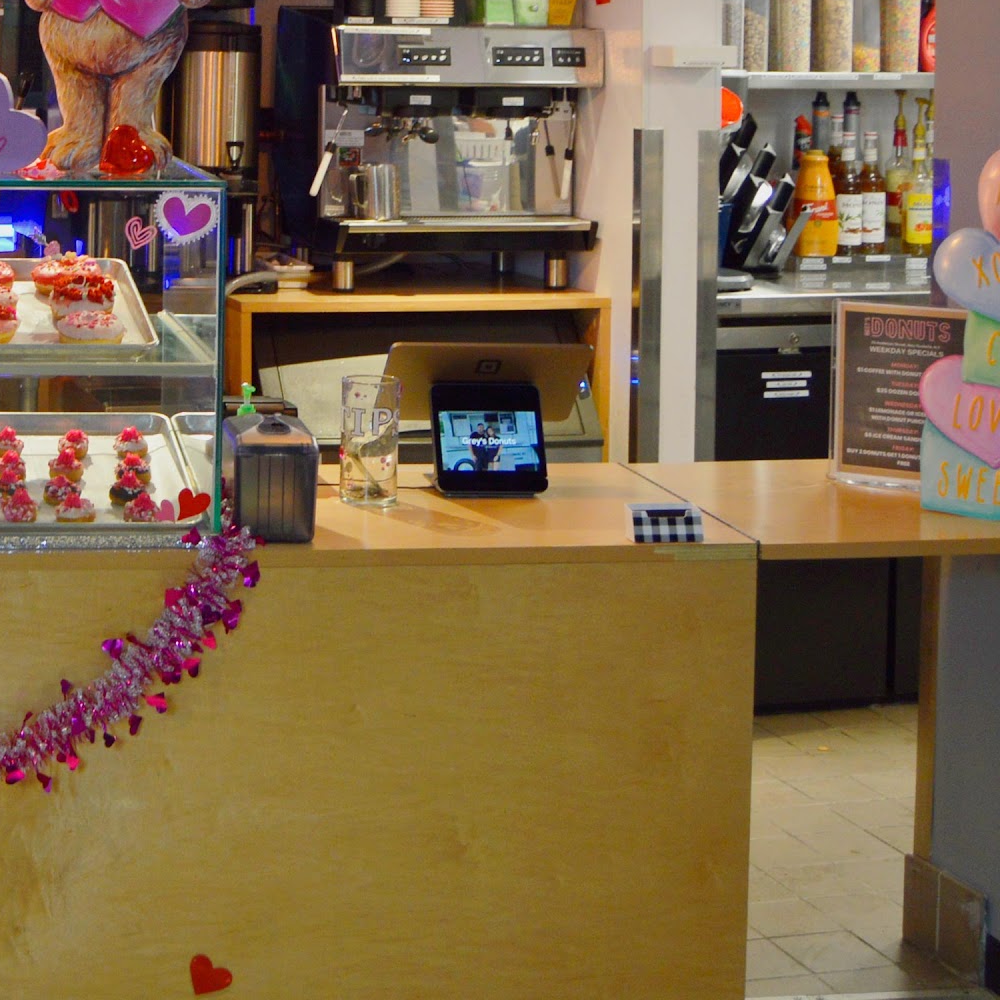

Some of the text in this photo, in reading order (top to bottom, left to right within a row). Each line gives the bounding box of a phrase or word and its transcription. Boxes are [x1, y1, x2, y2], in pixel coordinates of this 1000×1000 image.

[871, 317, 951, 343] DONUTS
[869, 346, 944, 357] WEEKDAY SPECIALS
[462, 437, 516, 446] Grey's Donuts
